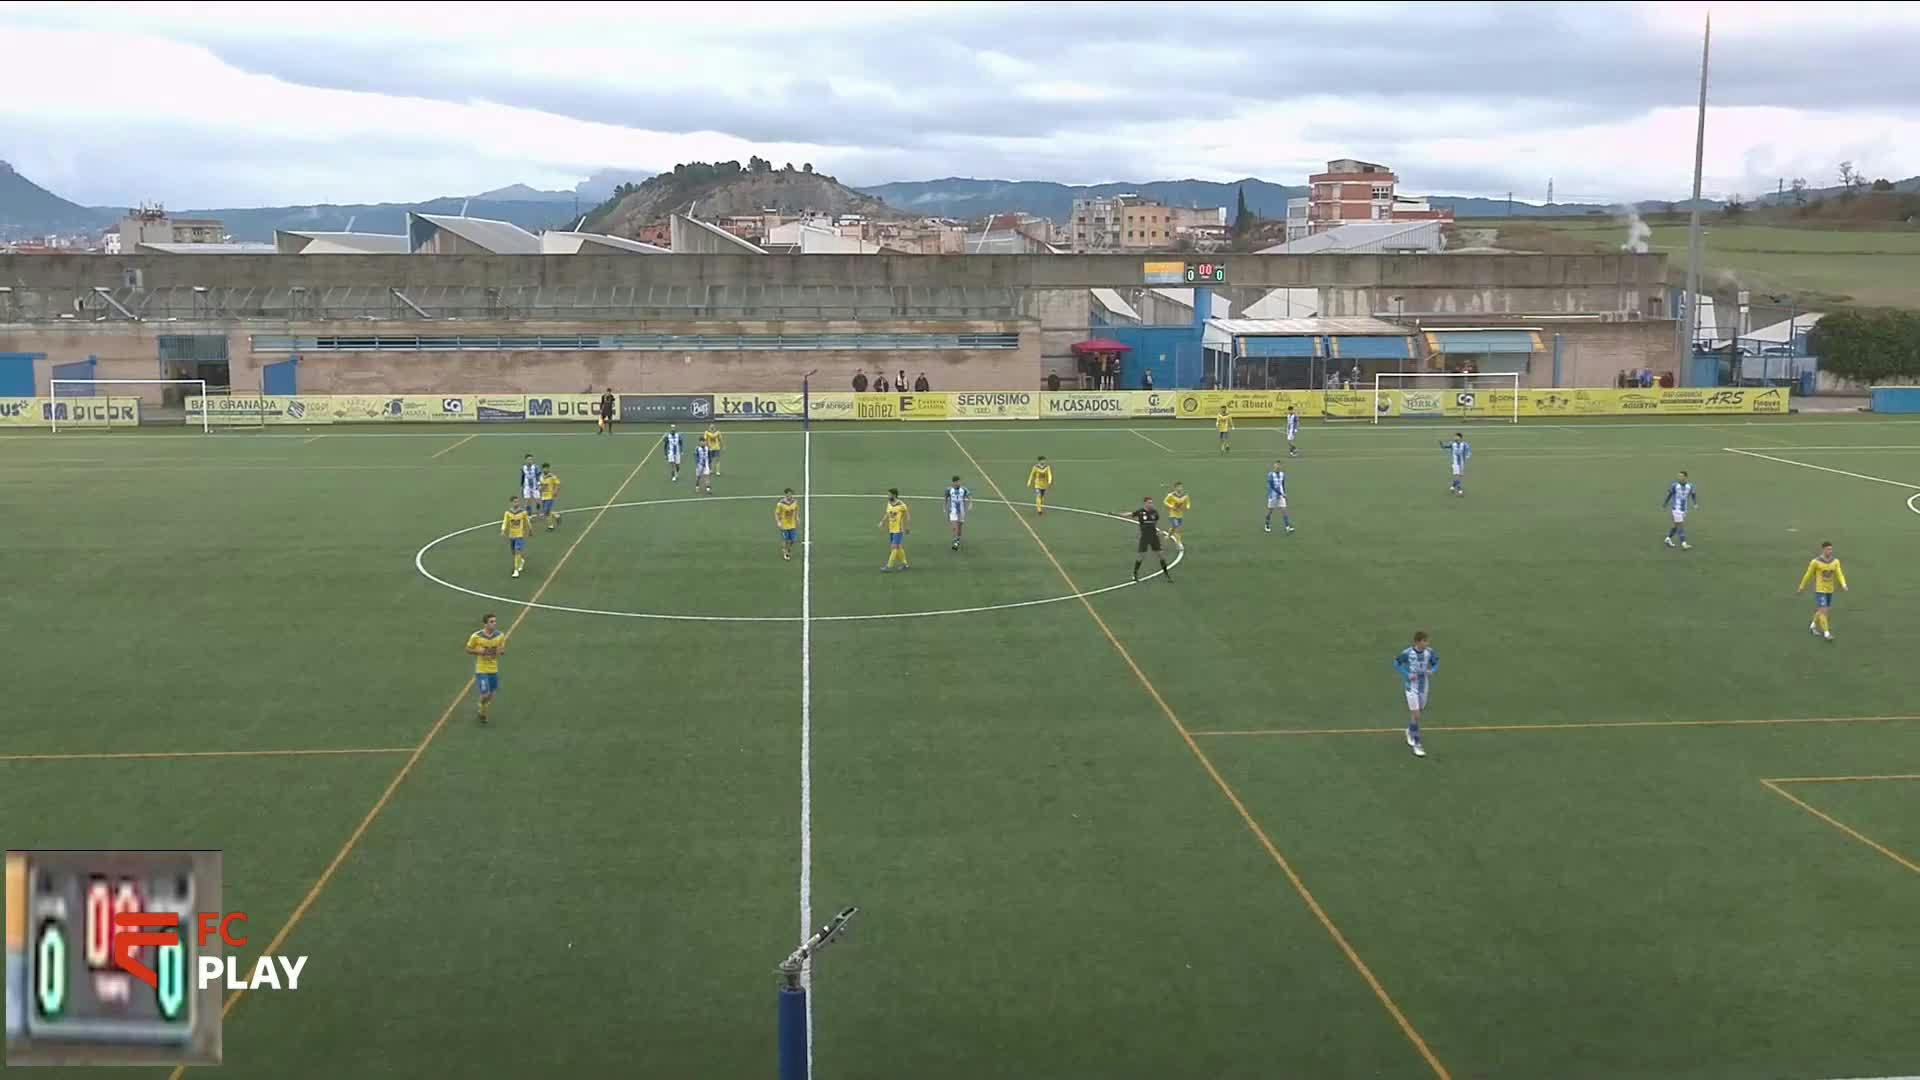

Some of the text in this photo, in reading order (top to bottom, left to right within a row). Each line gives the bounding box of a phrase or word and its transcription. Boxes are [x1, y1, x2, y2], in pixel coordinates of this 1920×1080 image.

[958, 394, 1030, 405] SERVISIMO
[1705, 391, 1744, 406] ARS
[191, 400, 277, 409] BAR GRANADA
